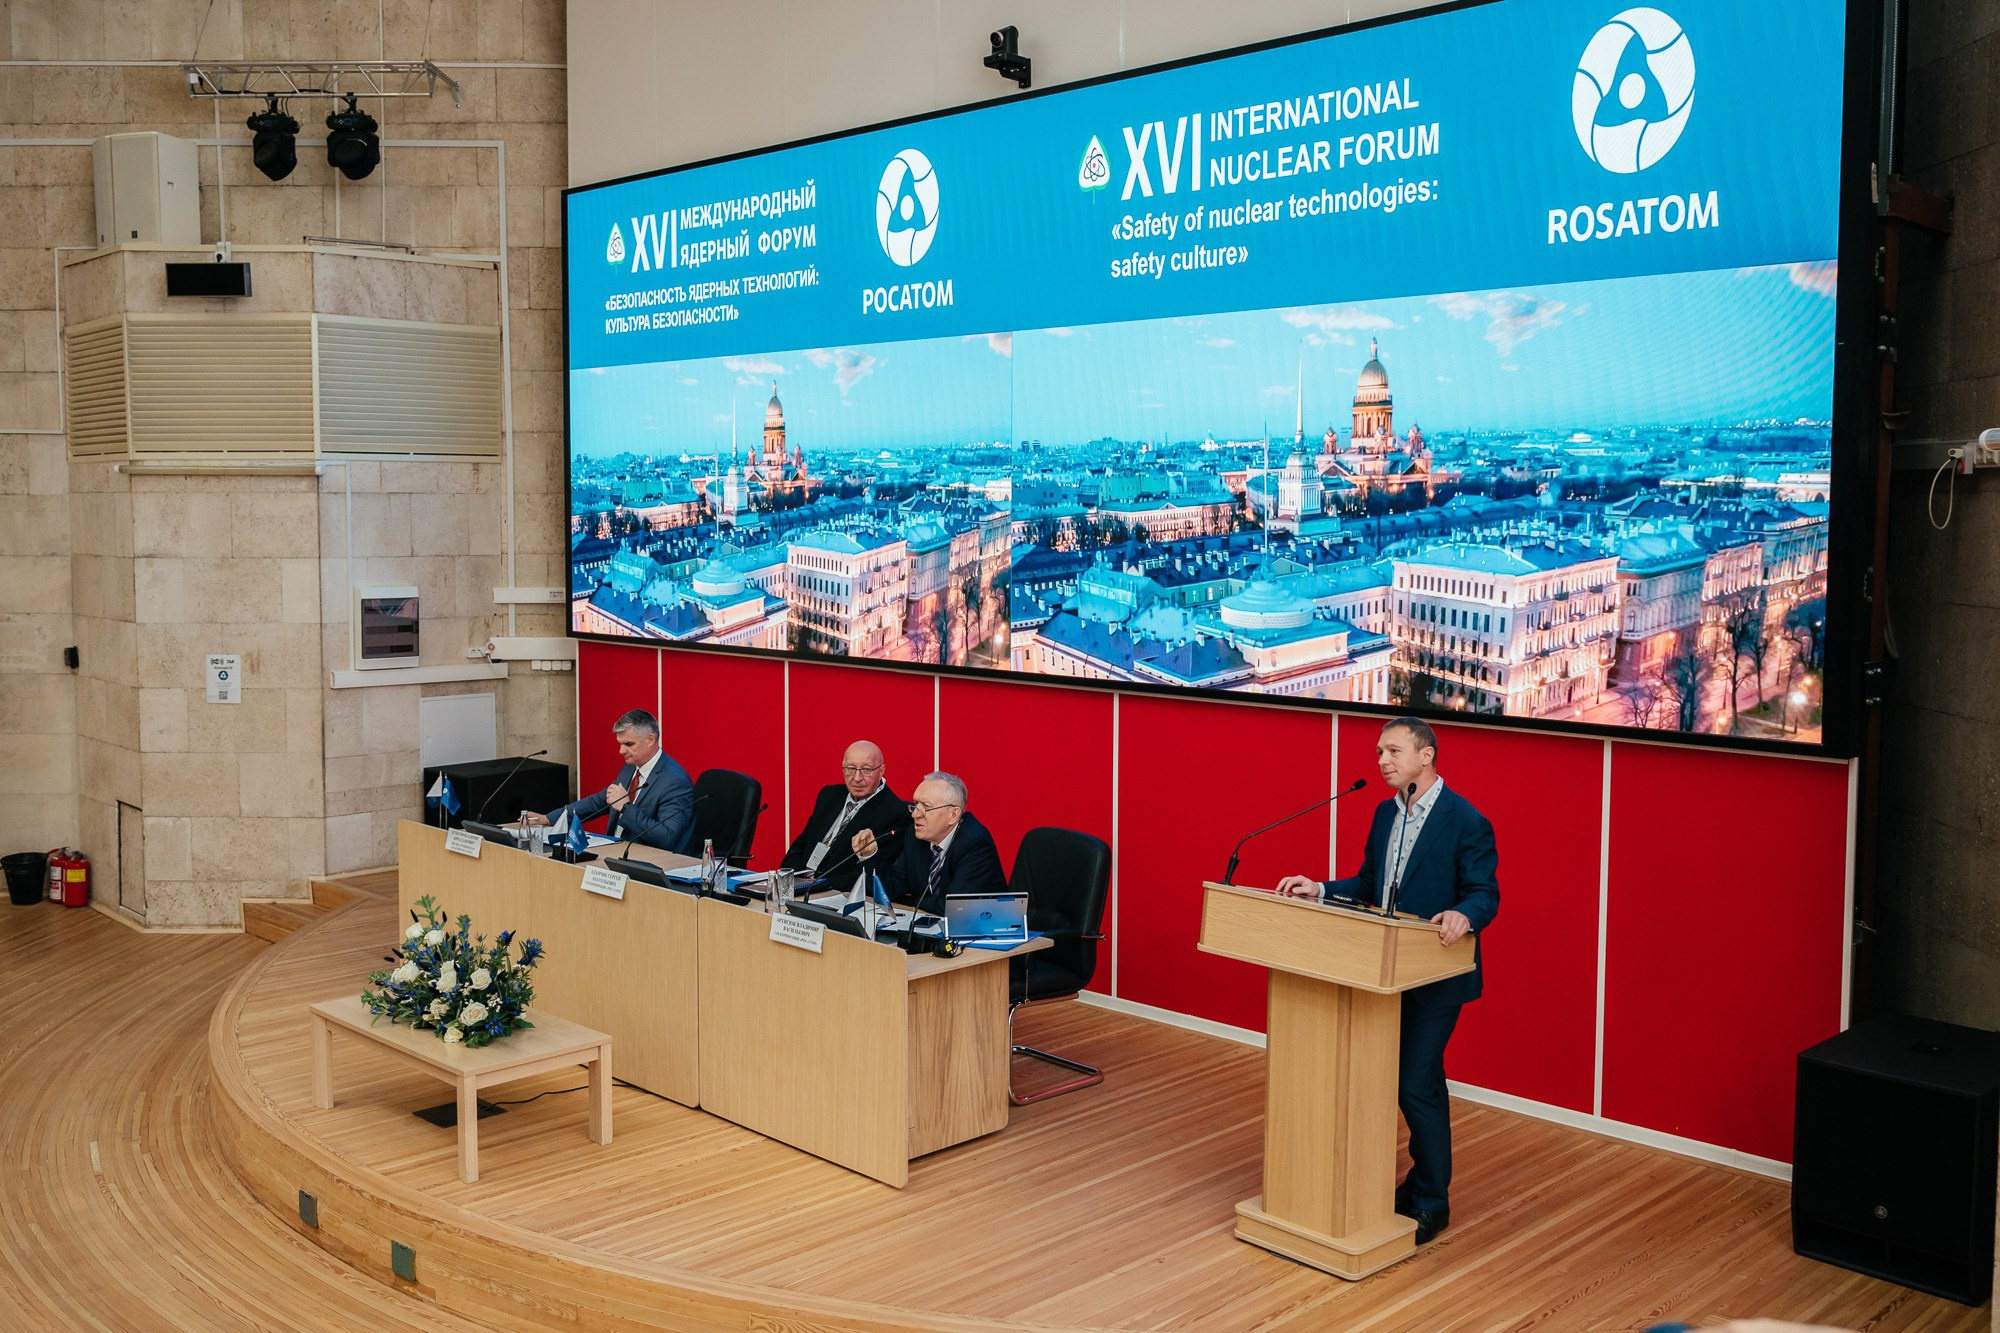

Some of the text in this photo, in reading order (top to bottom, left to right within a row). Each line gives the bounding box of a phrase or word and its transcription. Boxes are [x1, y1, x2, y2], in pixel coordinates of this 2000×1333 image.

[1211, 78, 1419, 141] INTERNATIONAL
[1211, 123, 1439, 187] NUCLEAR FORUM
[681, 179, 815, 230] МЕЖДУНАРОДНЫЙ
[1112, 178, 1437, 240] «Safety of nuclear technologies:
[1548, 191, 1719, 244] ROSATOM
[681, 224, 816, 268] ЯДЕРНЫЙ ФОРУМ
[1111, 245, 1248, 279] safety culture»
[605, 264, 818, 310] «БЕЗОПАСНОСТЬ ЯДЕРНЫХ ТЕХНОЛОГИЙ:
[863, 280, 953, 314] РОСАТОМ
[606, 305, 739, 334] КУЛЬТУРА БЕЗОПАСНОСТИ»
